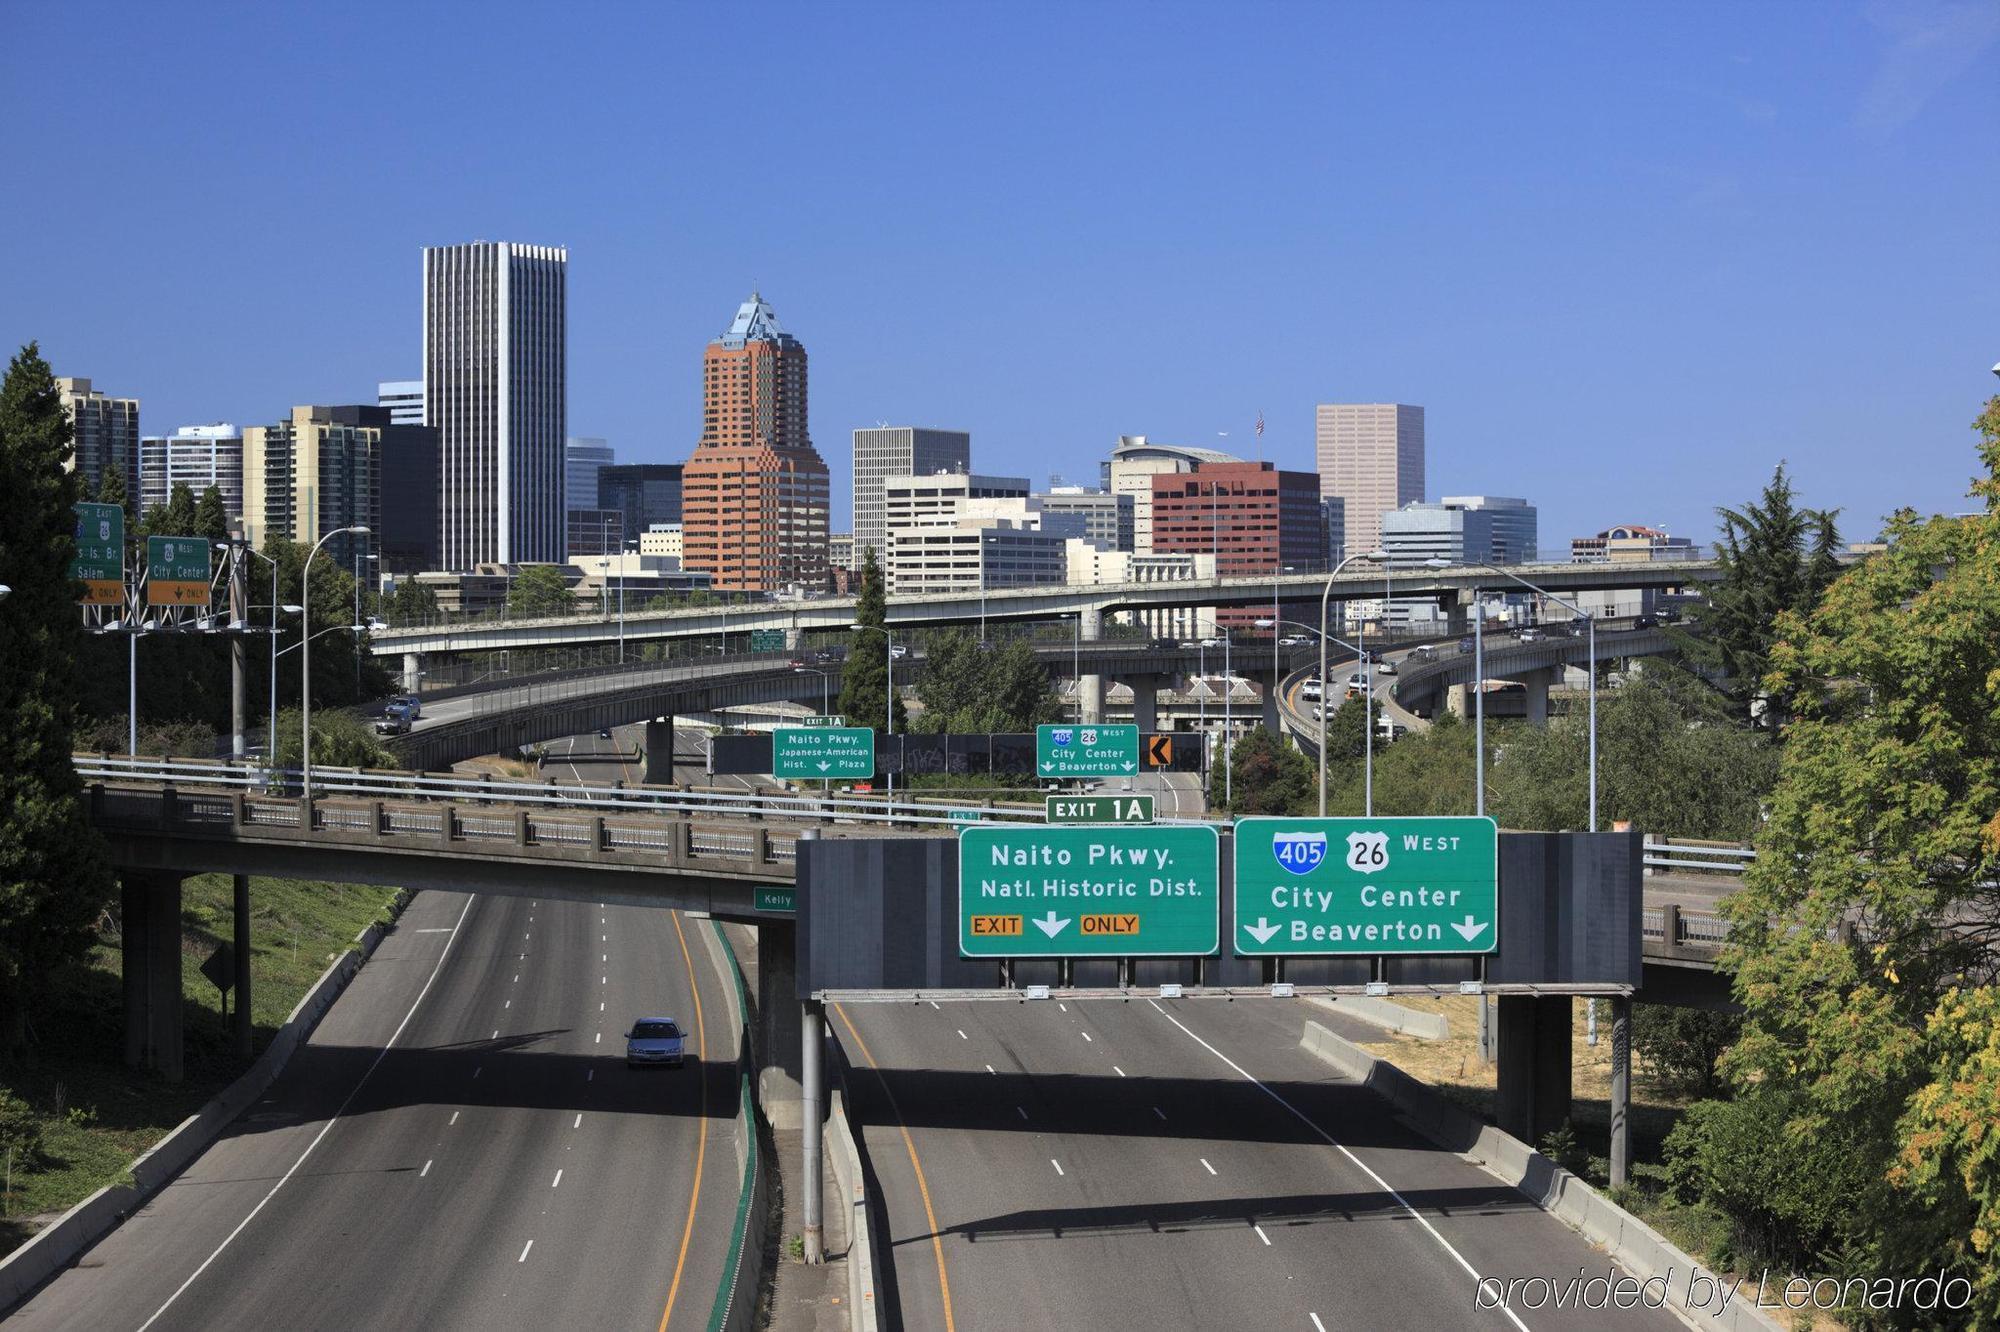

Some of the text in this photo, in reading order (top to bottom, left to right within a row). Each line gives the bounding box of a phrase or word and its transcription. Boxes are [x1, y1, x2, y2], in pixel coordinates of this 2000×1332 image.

[96, 508, 113, 518] EAST
[78, 566, 105, 579] Salem
[153, 565, 204, 580] City Center
[99, 588, 117, 598] ONLY
[186, 588, 203, 598] ONLY
[828, 717, 842, 726] 1A
[788, 735, 859, 745] Naito Pkwy.
[1054, 729, 1125, 742] 405 26 WEST
[779, 748, 868, 757] Japanese-American
[1051, 749, 1125, 760] City Center
[783, 760, 865, 768] Hist. Plaza
[1059, 761, 1117, 771] Beaverton
[1055, 800, 1145, 820] EXIT 1A
[1279, 834, 1461, 865] 405 26 WEST
[991, 844, 1174, 869] Naito Pkwy.
[981, 878, 1202, 897] Natl. Historic Dist.
[764, 894, 791, 907] Kelly
[1271, 885, 1461, 912] City Center
[974, 916, 1137, 933] EXIT ONLY
[1291, 920, 1441, 942] Beaverton
